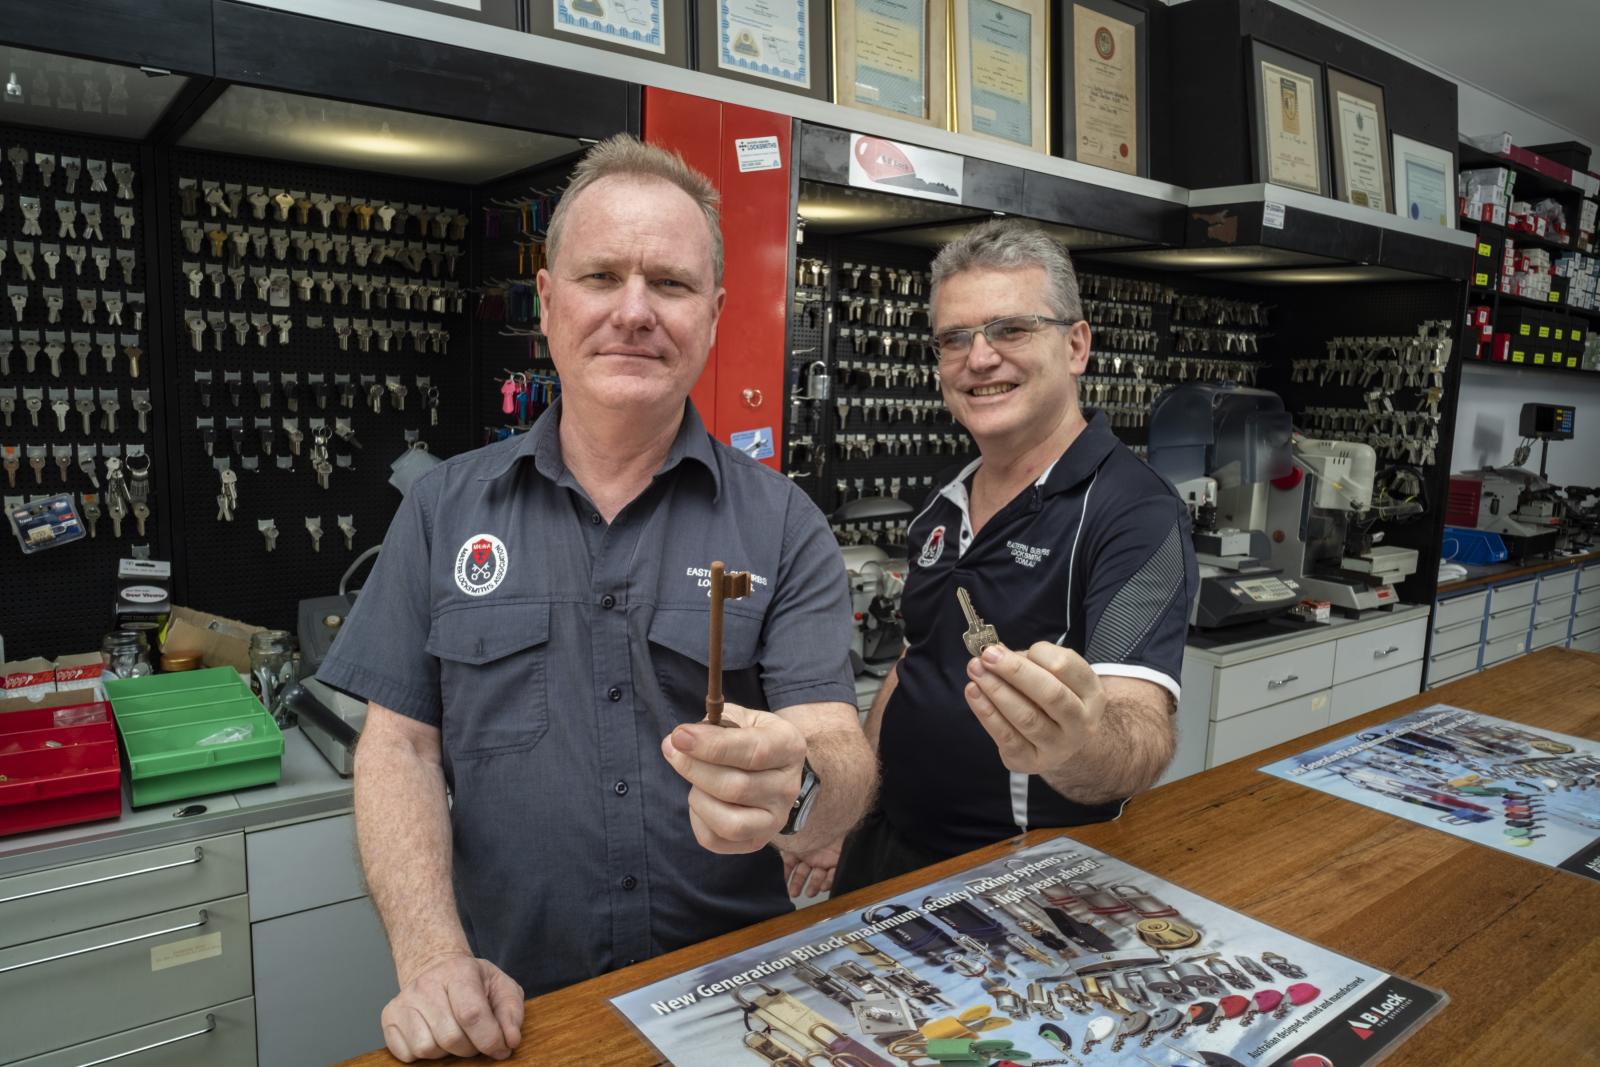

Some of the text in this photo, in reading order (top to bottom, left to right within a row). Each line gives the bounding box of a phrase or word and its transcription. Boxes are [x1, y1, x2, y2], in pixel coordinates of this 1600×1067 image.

[457, 547, 468, 574] MASTER
[1026, 875, 1062, 894] years
[1058, 859, 1100, 881] ahead!
[650, 991, 697, 1016] New
[696, 954, 795, 998] Generation
[792, 933, 846, 962] BiLock
[846, 909, 921, 942] maximum
[918, 888, 975, 914] security
[965, 872, 1019, 894] locking
[1014, 856, 1061, 879] systems
[1247, 1038, 1281, 1059] Australian
[1302, 1005, 1324, 1023] owned
[1319, 999, 1334, 1010] and
[1328, 976, 1366, 1003] manufactured
